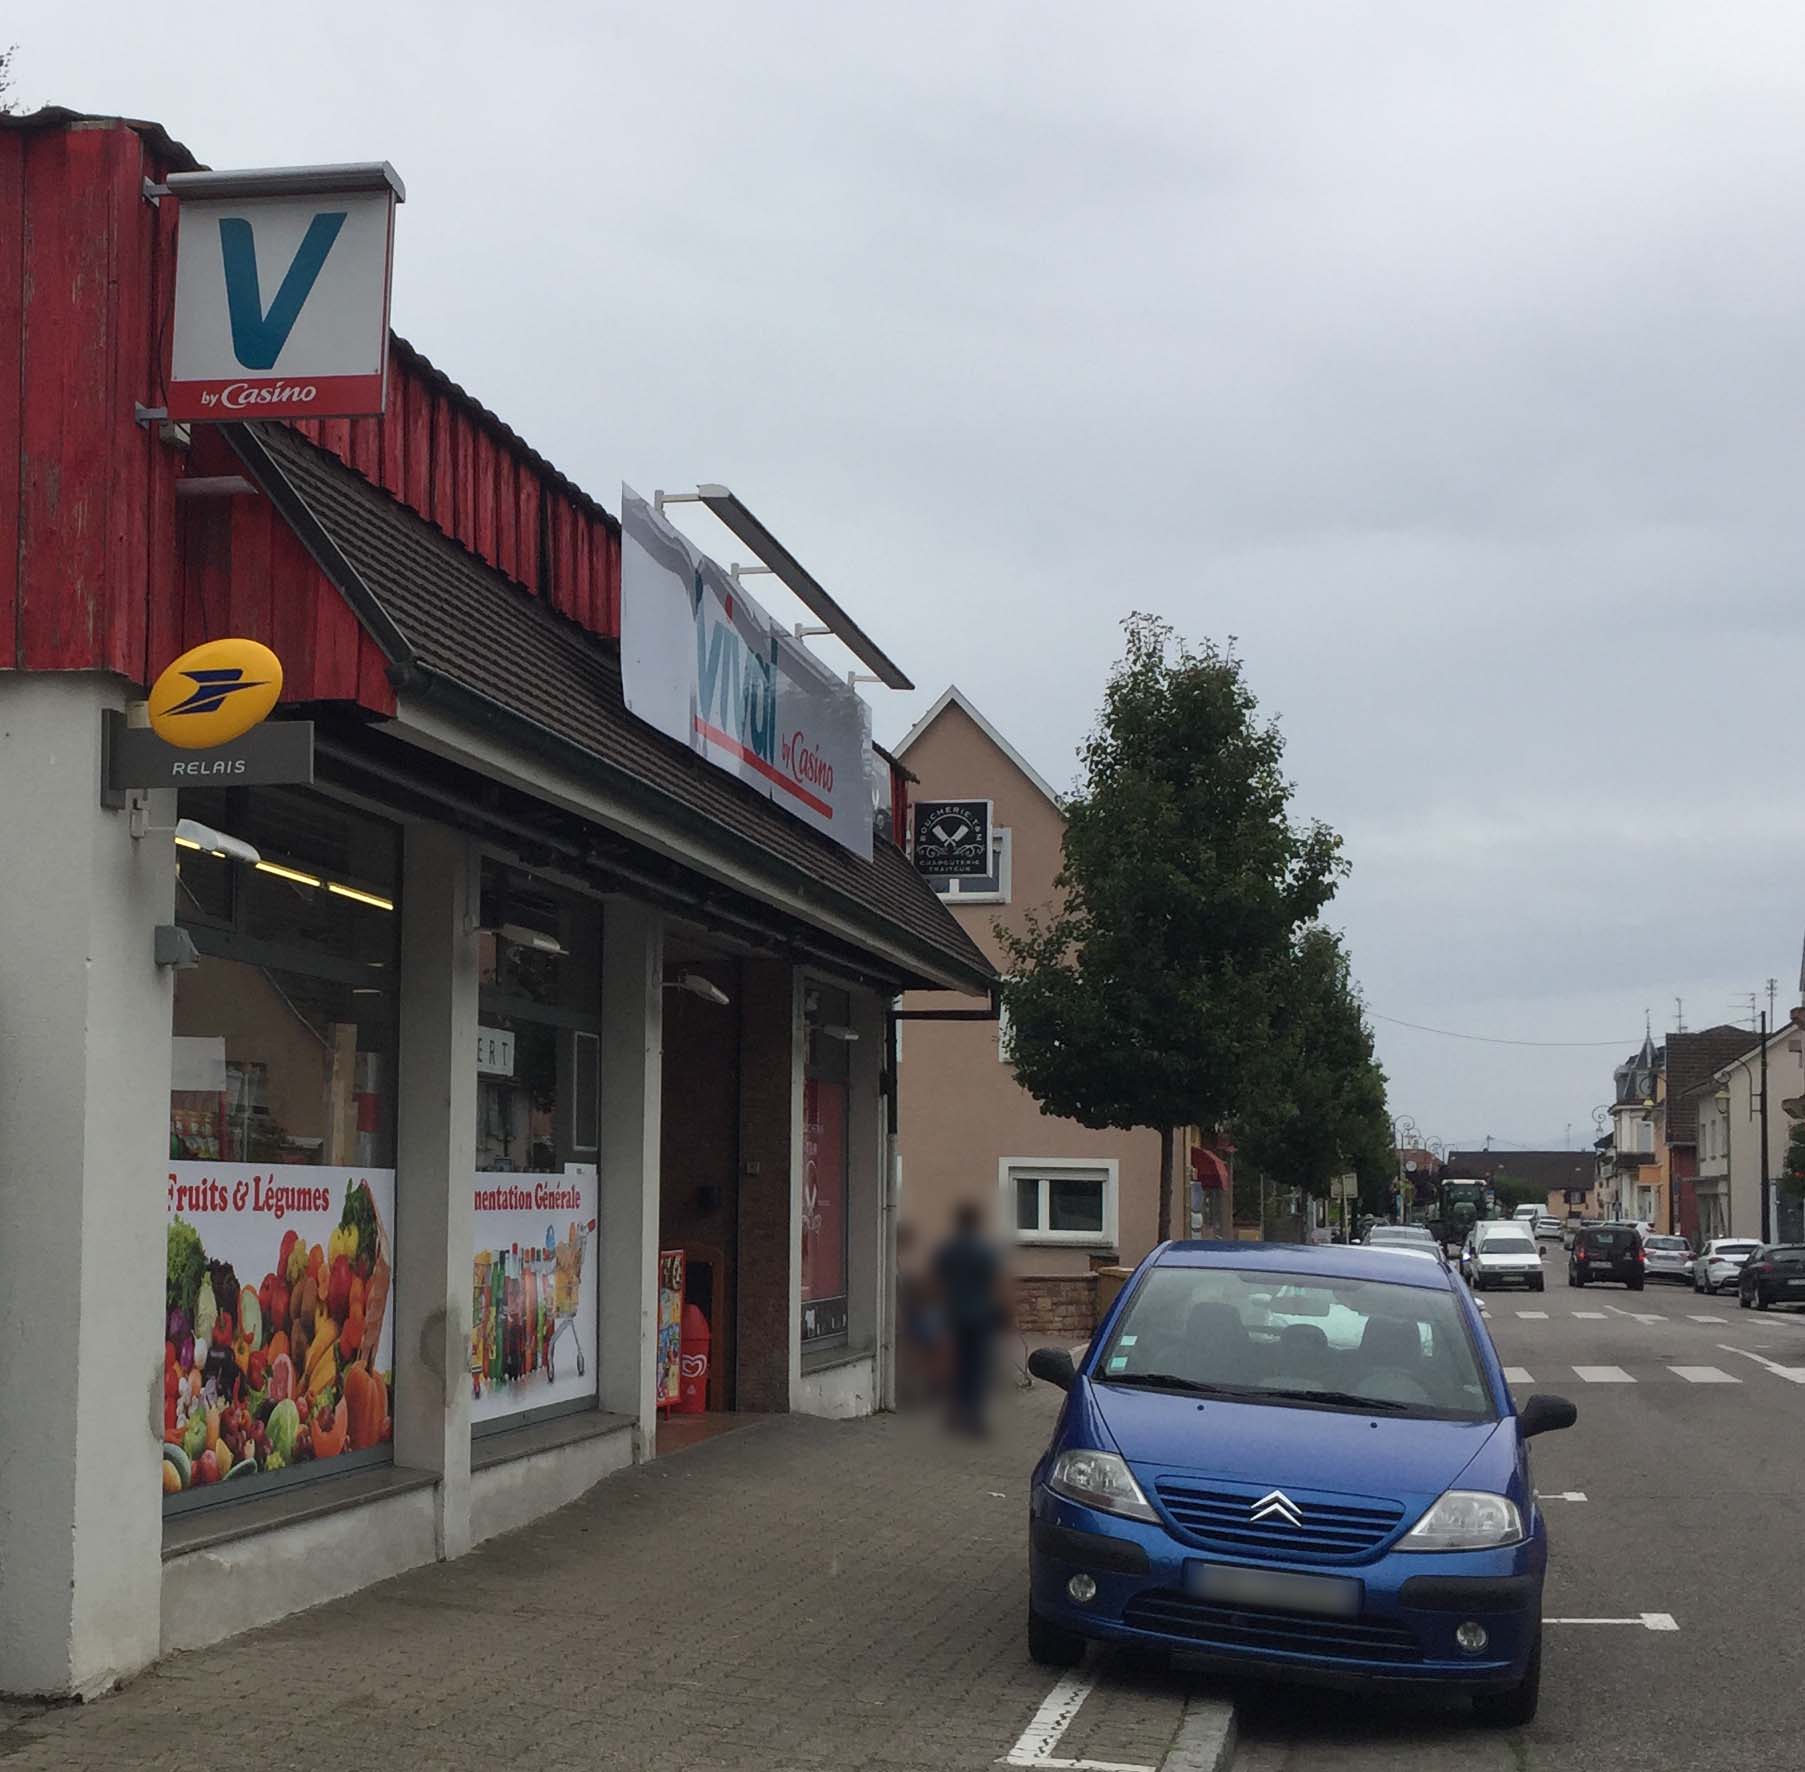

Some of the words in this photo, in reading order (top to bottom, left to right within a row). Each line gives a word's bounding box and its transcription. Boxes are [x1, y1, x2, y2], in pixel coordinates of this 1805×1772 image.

[218, 211, 348, 370] V
[200, 390, 218, 407] by
[220, 381, 317, 409] Casino
[172, 760, 246, 775] RELAIS
[782, 733, 791, 768] by
[791, 730, 834, 793] Casino
[919, 806, 972, 842] BOUCHERIE
[233, 1180, 249, 1212] &
[253, 1173, 329, 1219] Légumes
[535, 1181, 581, 1210] Générale
